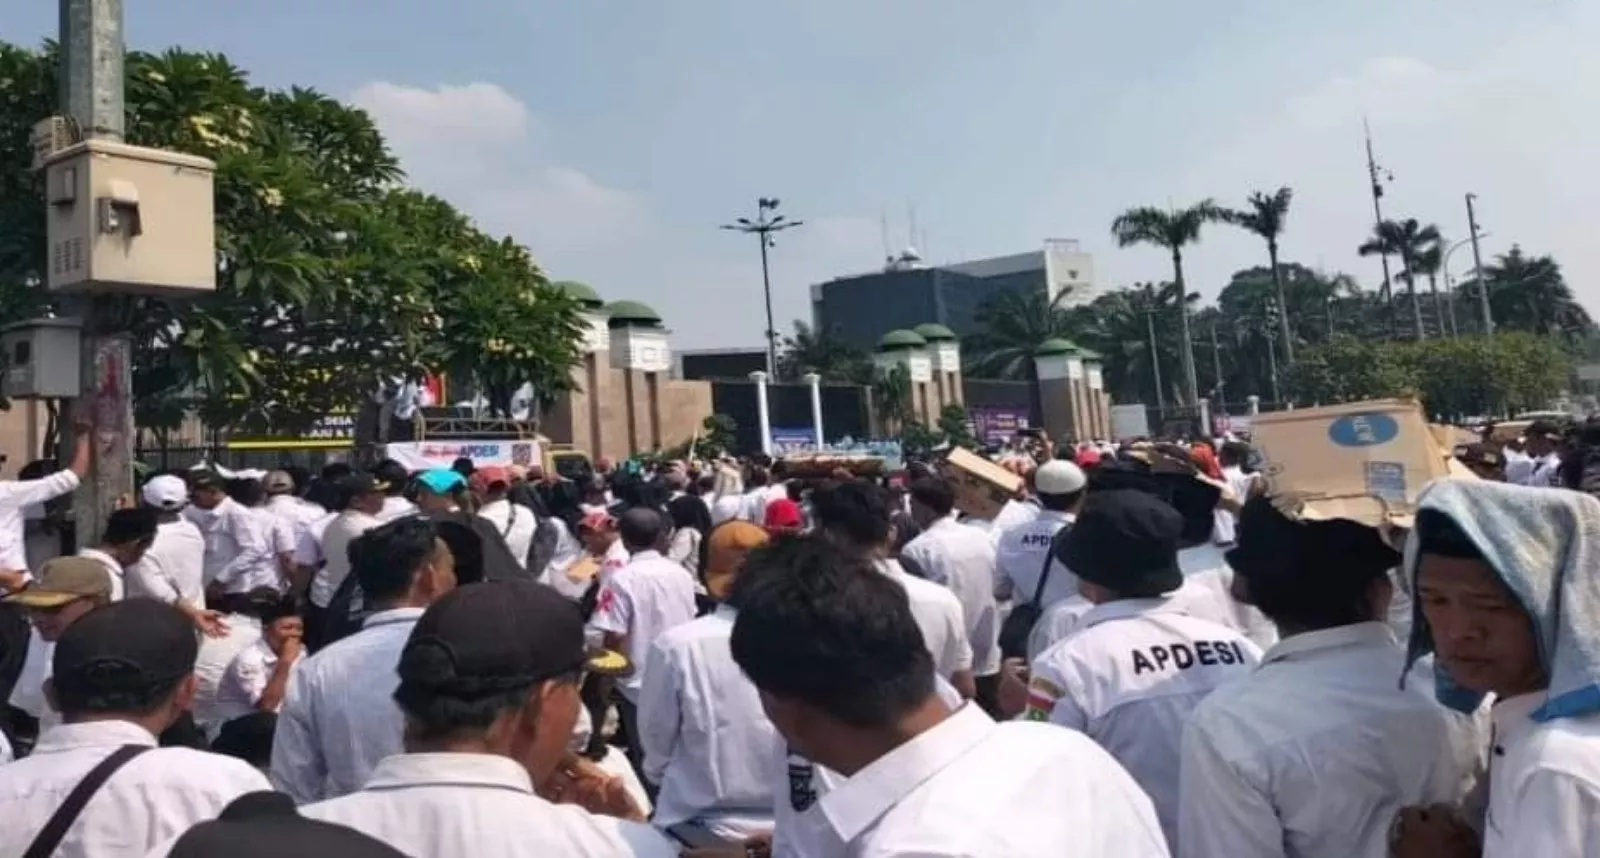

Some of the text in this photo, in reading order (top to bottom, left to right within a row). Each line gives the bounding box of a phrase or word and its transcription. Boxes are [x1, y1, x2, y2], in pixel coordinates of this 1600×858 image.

[459, 444, 499, 458] APDESI
[1020, 534, 1051, 546] APD
[1131, 640, 1245, 674] APDESI
